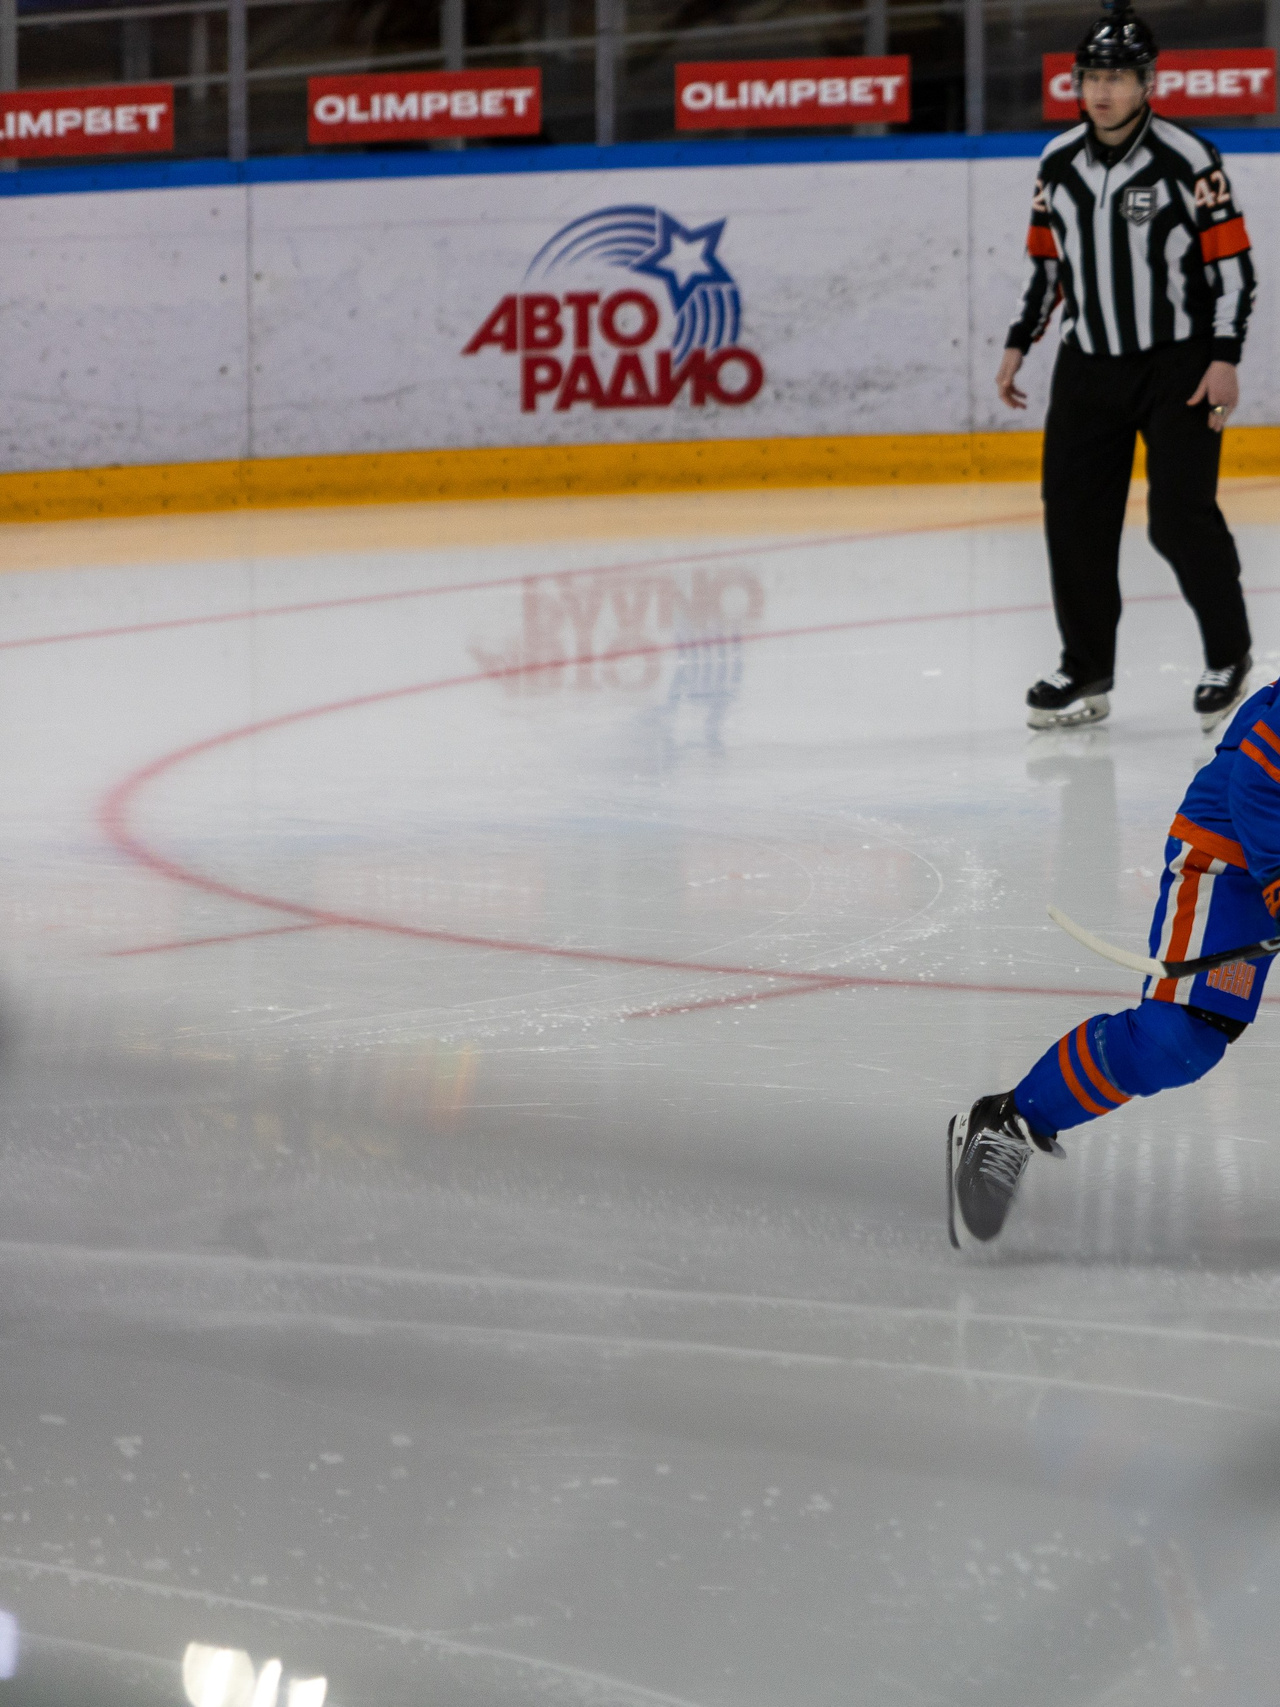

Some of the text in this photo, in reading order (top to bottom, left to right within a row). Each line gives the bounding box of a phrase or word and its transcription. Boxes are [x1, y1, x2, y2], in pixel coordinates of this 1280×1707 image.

[681, 75, 905, 112] OLIMPBET
[1050, 67, 1270, 100] OPBET
[0, 103, 167, 140] IMPBET
[314, 86, 536, 125] OLIMPBET
[1194, 170, 1230, 208] 42
[462, 289, 659, 354] АВТО
[520, 347, 764, 413] РАДИО
